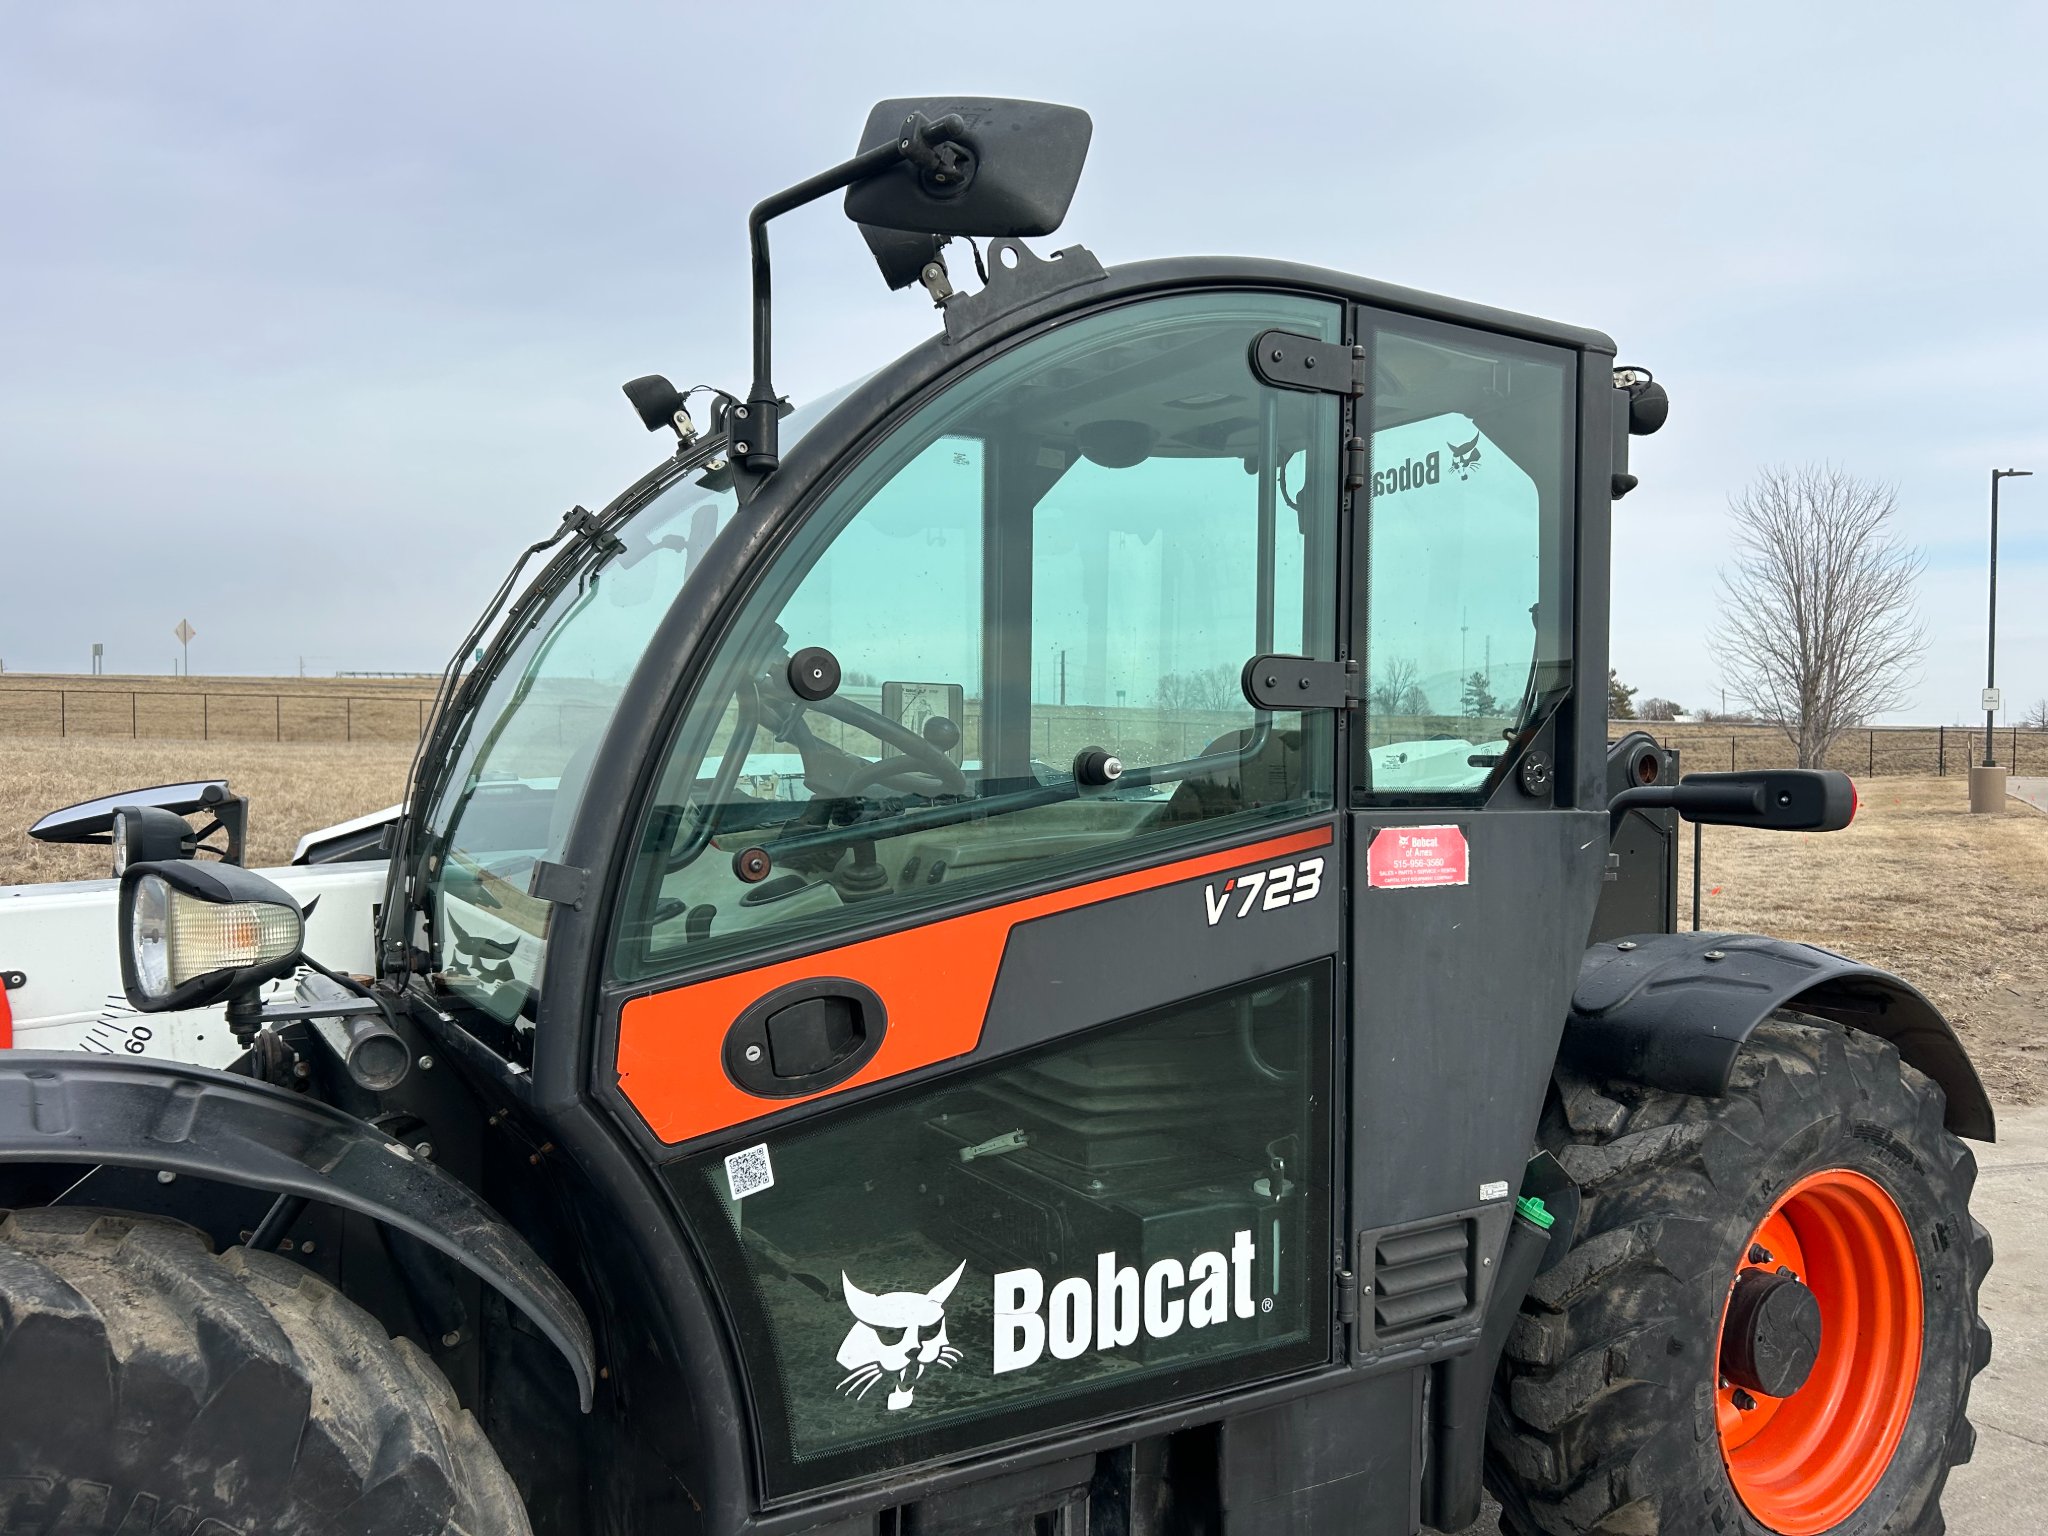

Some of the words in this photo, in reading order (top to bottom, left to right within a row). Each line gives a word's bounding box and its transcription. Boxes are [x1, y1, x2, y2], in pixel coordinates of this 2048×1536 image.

[1405, 848, 1413, 857] of
[1414, 847, 1433, 857] Ames
[1411, 837, 1438, 848] Bobcat
[1205, 856, 1325, 926] V723
[124, 1026, 153, 1054] 60
